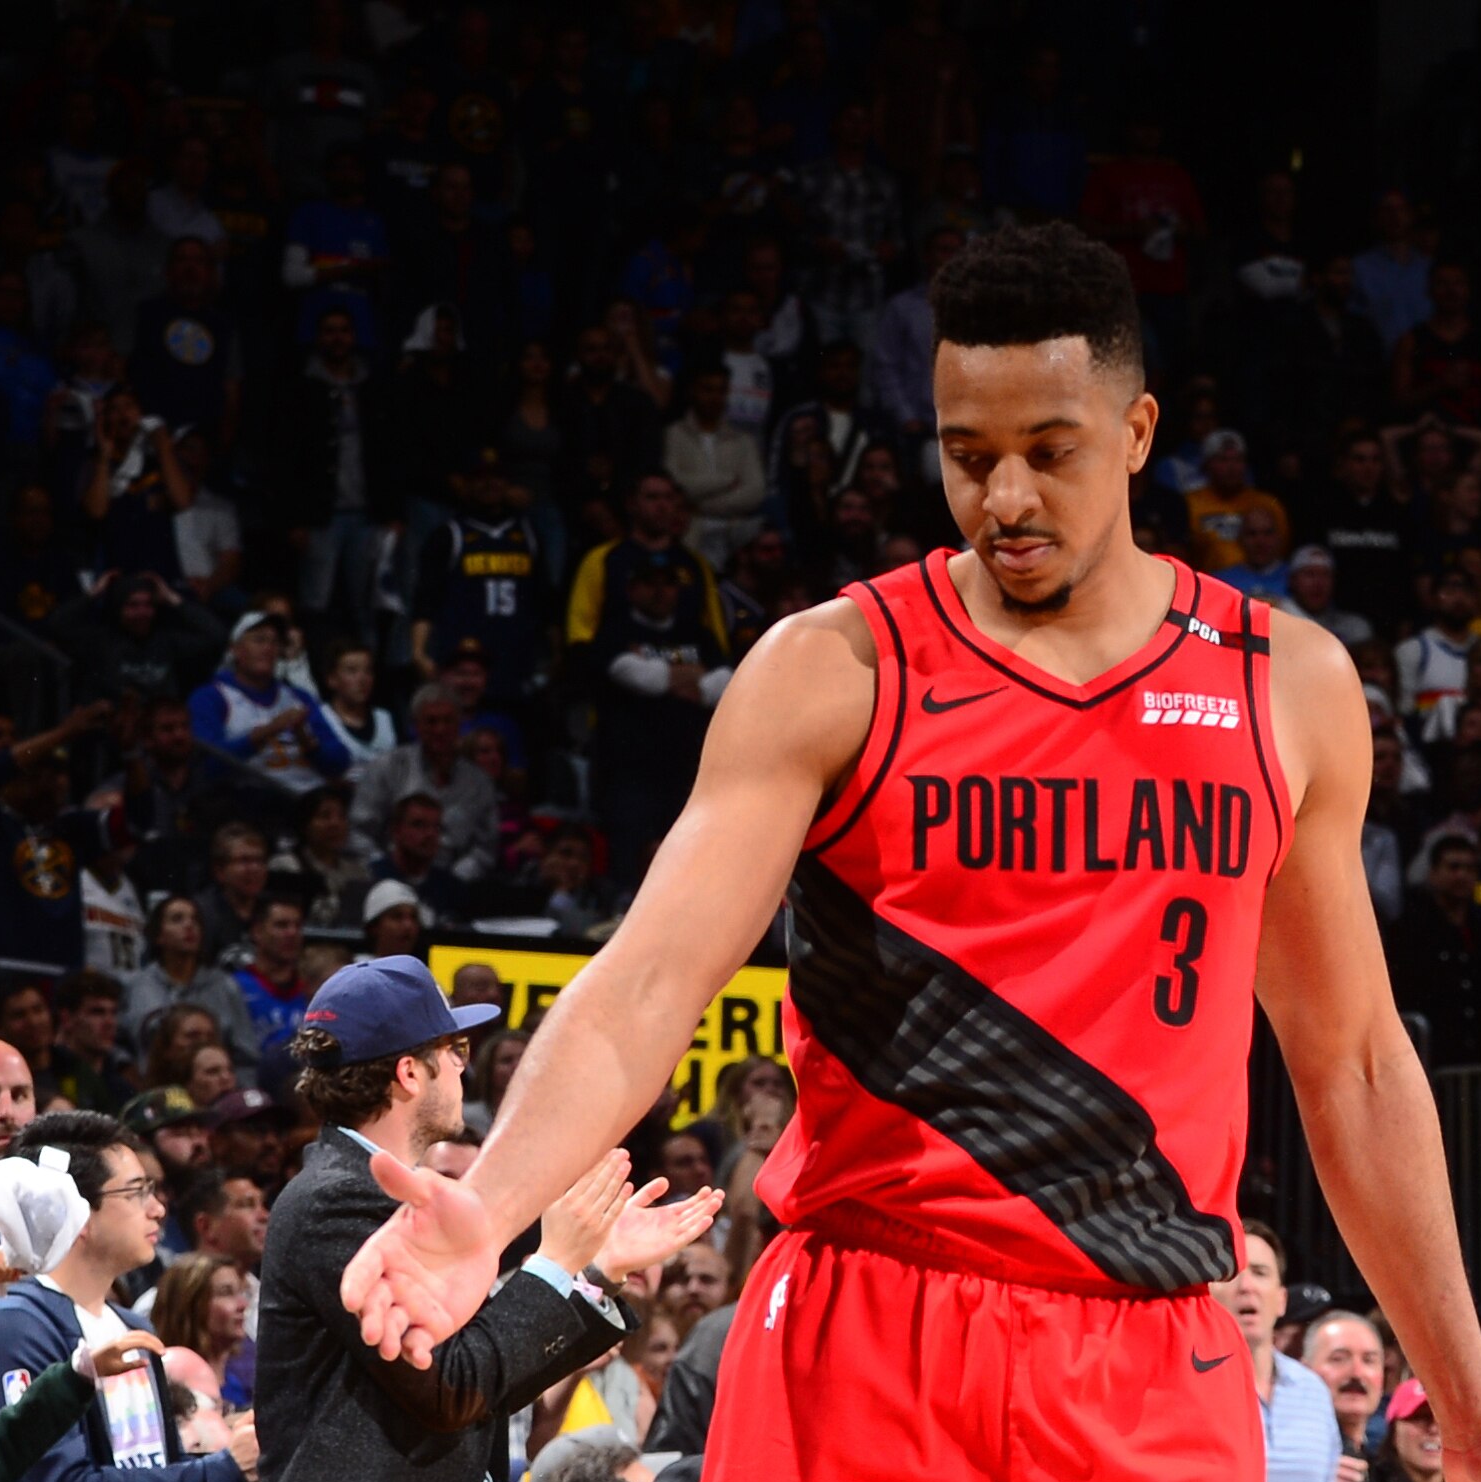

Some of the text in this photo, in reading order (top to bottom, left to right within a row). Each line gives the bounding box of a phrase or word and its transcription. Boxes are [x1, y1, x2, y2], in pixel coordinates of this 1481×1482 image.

[1188, 616, 1222, 646] PGA
[905, 774, 1252, 879] PORTLAND
[1153, 897, 1207, 1028] 3
